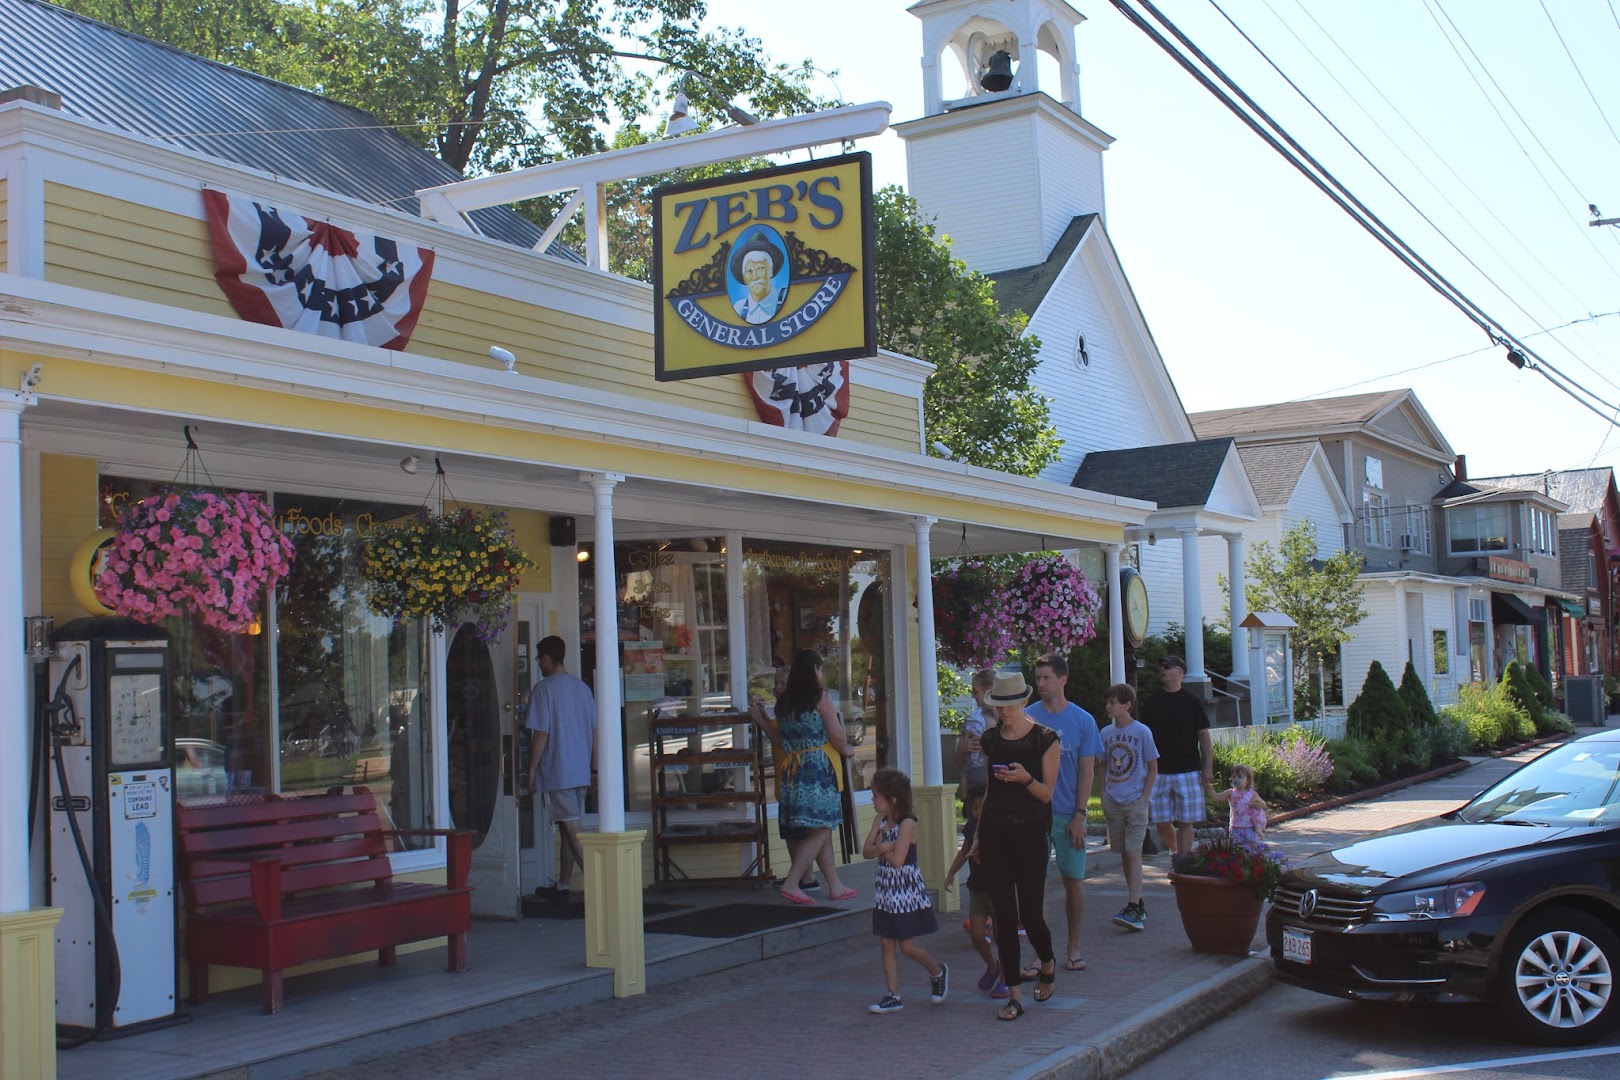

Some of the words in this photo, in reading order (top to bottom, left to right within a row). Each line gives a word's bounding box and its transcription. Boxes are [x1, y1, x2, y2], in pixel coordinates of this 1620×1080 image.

[673, 175, 844, 255] ZEB'S
[677, 298, 775, 347] GENERAL
[780, 276, 842, 338] STORE
[287, 508, 344, 537] Foods
[628, 551, 675, 569] Coffee
[633, 579, 671, 594] Soda
[640, 606, 671, 622] Toys
[1115, 734, 1139, 746] NAVY
[128, 795, 153, 803] CONTAINS
[132, 803, 150, 811] LEAD
[1297, 939, 1310, 957] 265
